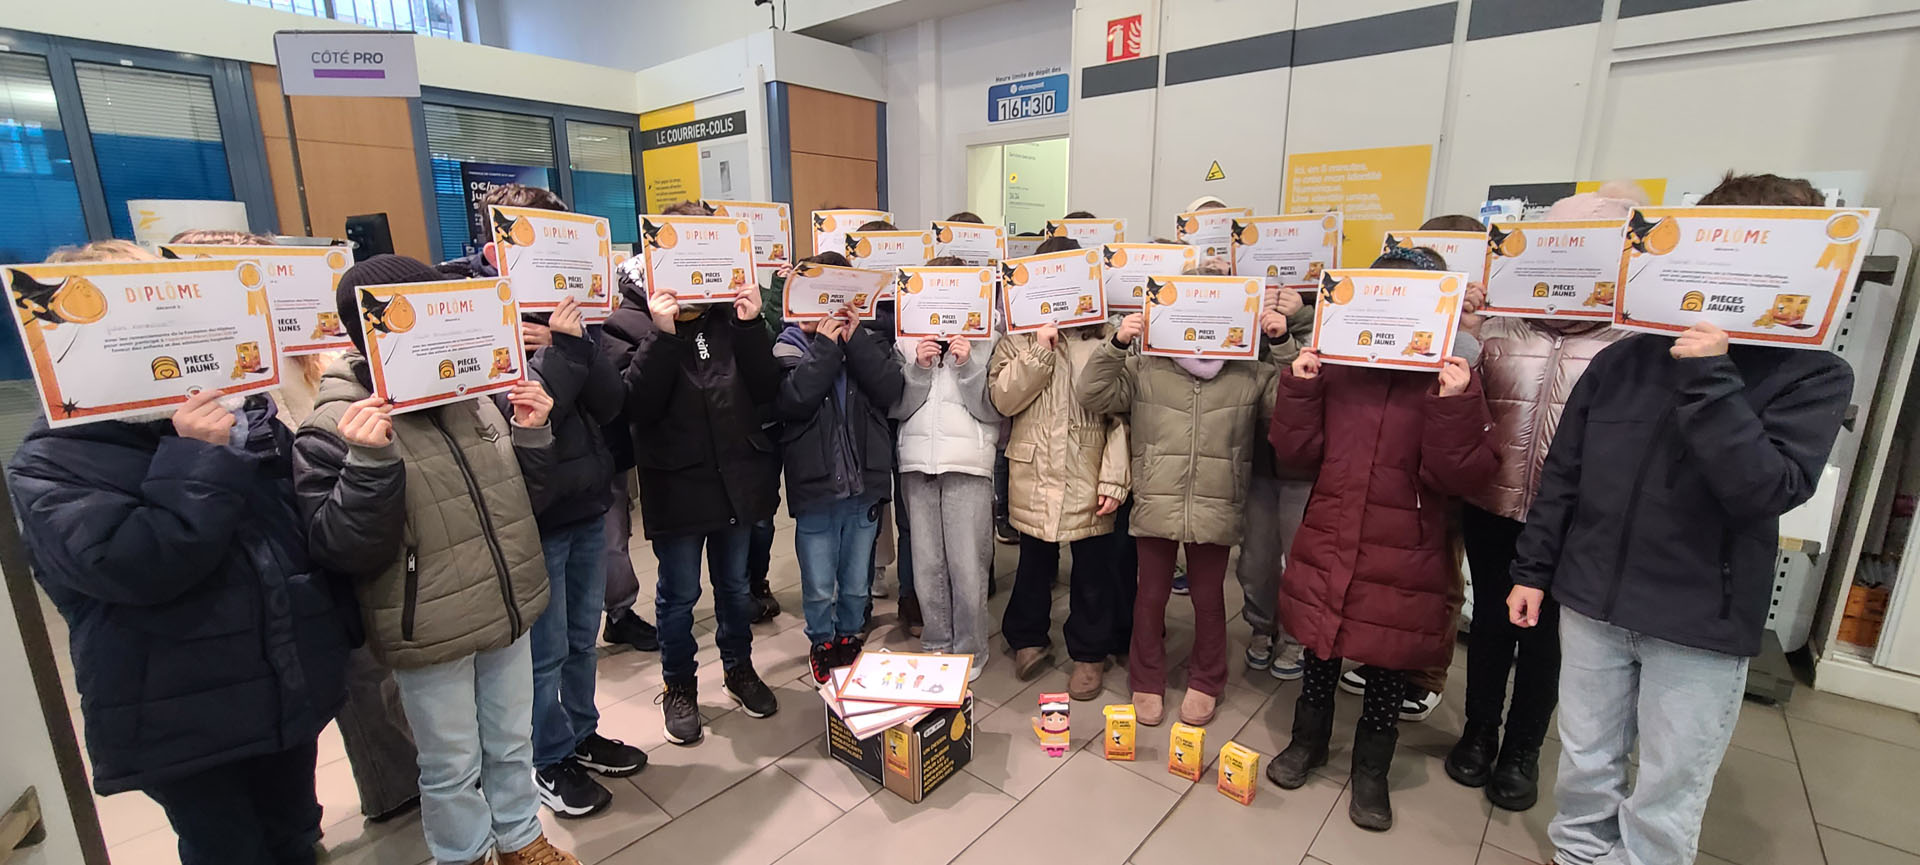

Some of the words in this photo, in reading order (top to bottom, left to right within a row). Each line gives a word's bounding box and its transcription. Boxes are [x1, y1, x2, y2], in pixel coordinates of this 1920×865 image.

[311, 50, 350, 64] CÔTÉ
[353, 52, 384, 64] PRO
[656, 130, 667, 145] LE
[667, 117, 734, 143] COURRIER-COLIS
[470, 181, 500, 191] 0€/m
[1706, 303, 1745, 313] JAUNES
[1374, 338, 1396, 346] JAUNES
[186, 361, 220, 374] JAUNES
[458, 364, 481, 375] JAUNES
